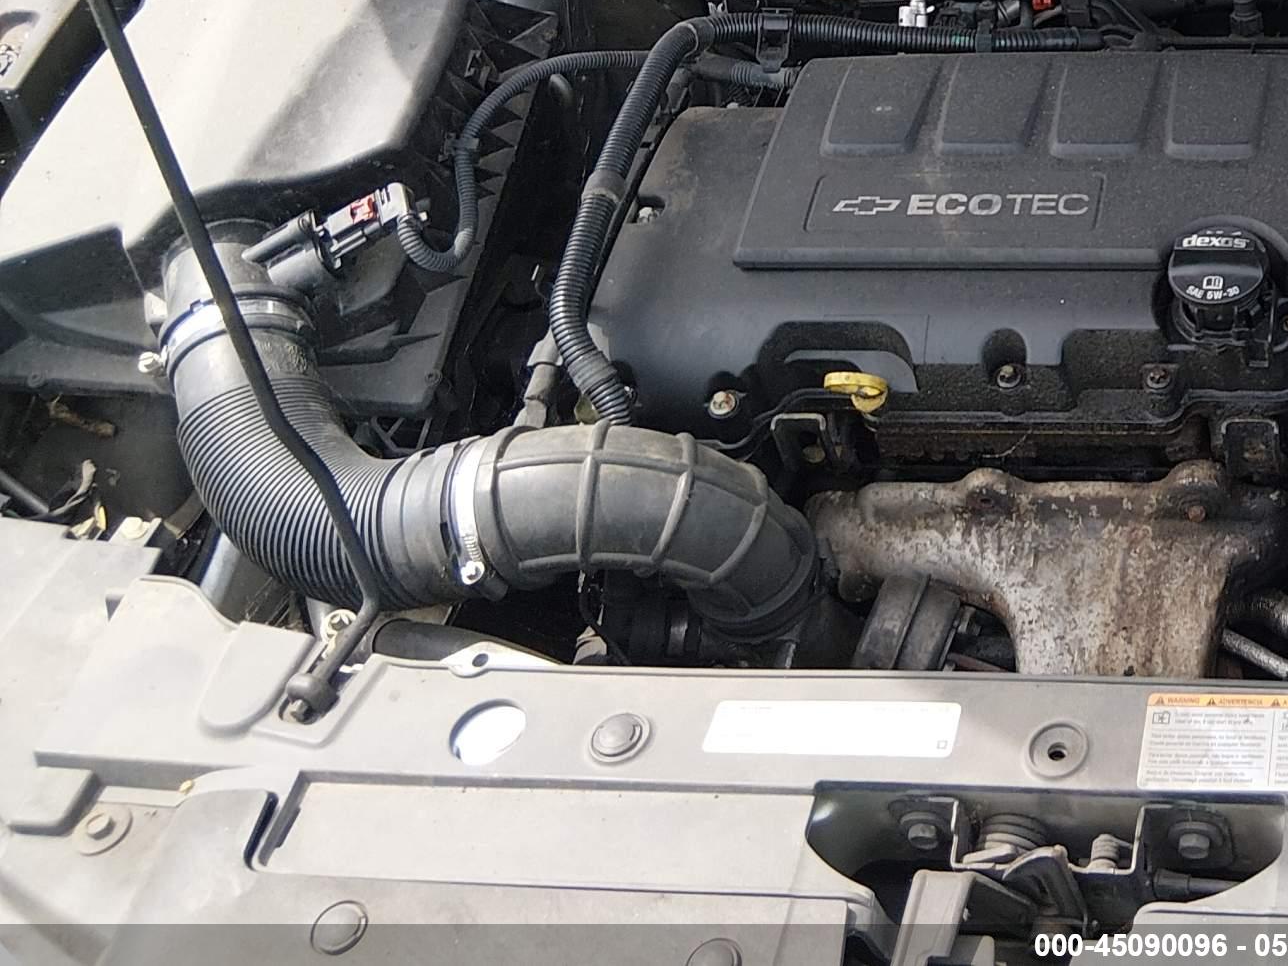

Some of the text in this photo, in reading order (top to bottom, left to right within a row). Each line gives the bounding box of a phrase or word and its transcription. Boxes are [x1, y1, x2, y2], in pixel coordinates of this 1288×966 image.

[906, 193, 1090, 216] ECOTEC
[1182, 234, 1248, 248] dexos
[1186, 285, 1204, 299] SAE
[1167, 696, 1200, 705] WARNING
